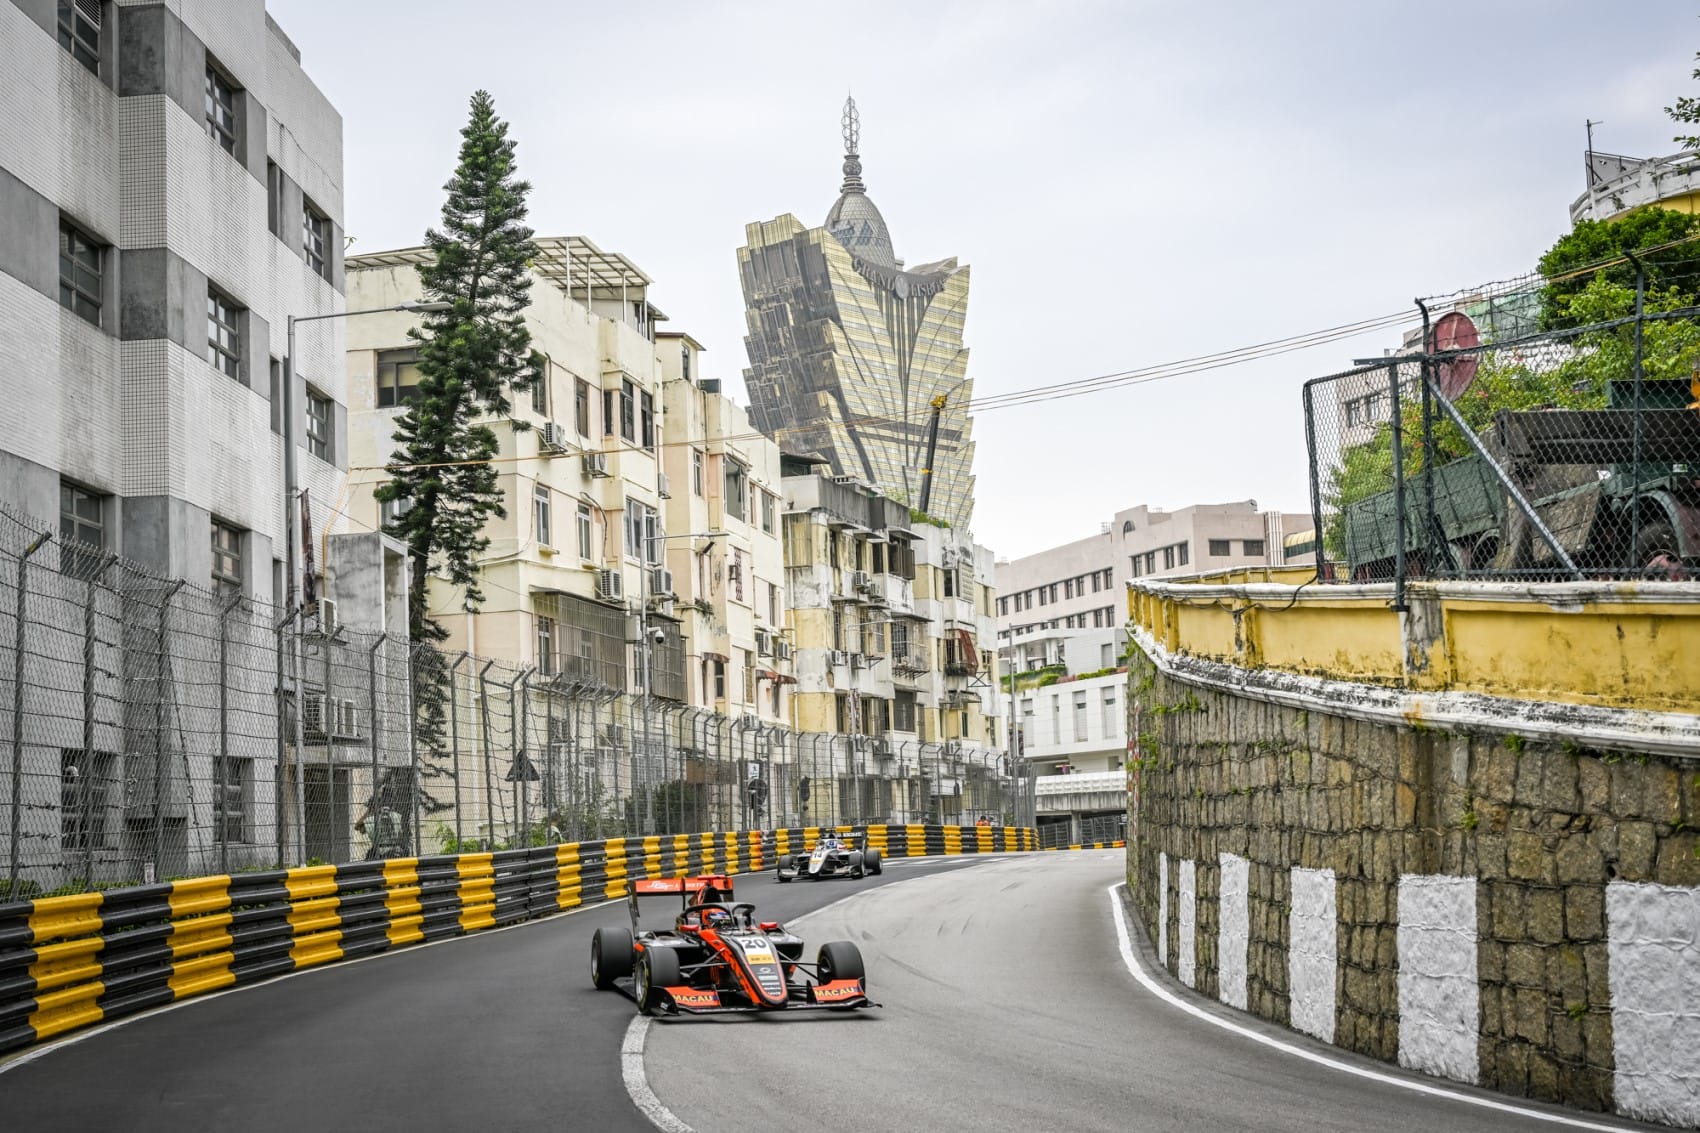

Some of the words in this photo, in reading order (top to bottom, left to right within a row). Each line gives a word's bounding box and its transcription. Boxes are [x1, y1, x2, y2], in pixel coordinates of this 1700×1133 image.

[853, 257, 895, 291] GRAND
[741, 939, 767, 949] 20
[814, 987, 854, 997] MACAU
